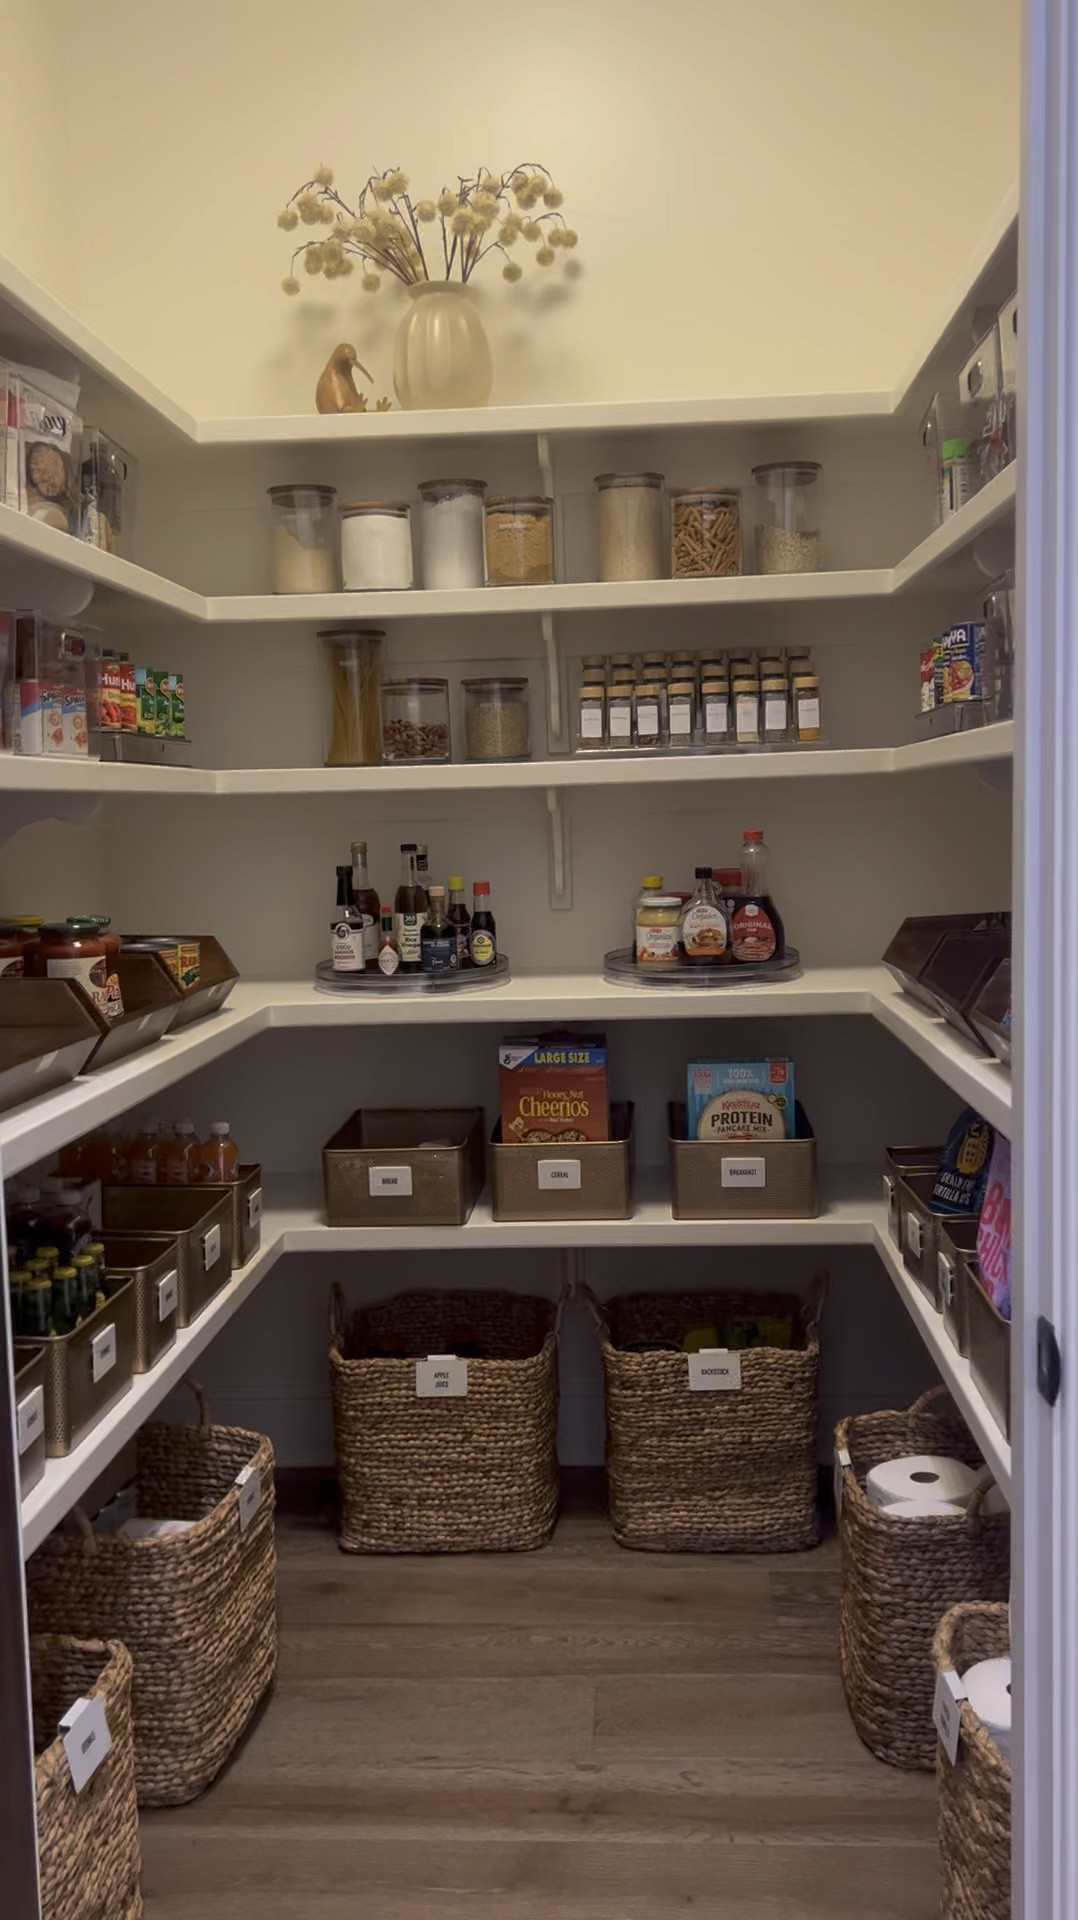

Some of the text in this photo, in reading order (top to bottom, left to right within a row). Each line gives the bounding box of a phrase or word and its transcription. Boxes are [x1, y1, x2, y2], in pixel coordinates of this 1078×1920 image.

[734, 922, 772, 930] ORIGINAL
[533, 1052, 566, 1064] LARGE
[567, 1052, 590, 1064] SIZE
[542, 1089, 585, 1101] Honey Nut
[519, 1095, 590, 1117] Cheerios
[711, 1111, 773, 1128] PROTEIN
[551, 1171, 569, 1179] CEREAL
[433, 1371, 450, 1379] APPLE
[700, 1368, 730, 1376] BACKSTOCK
[434, 1381, 449, 1389] JUICE
